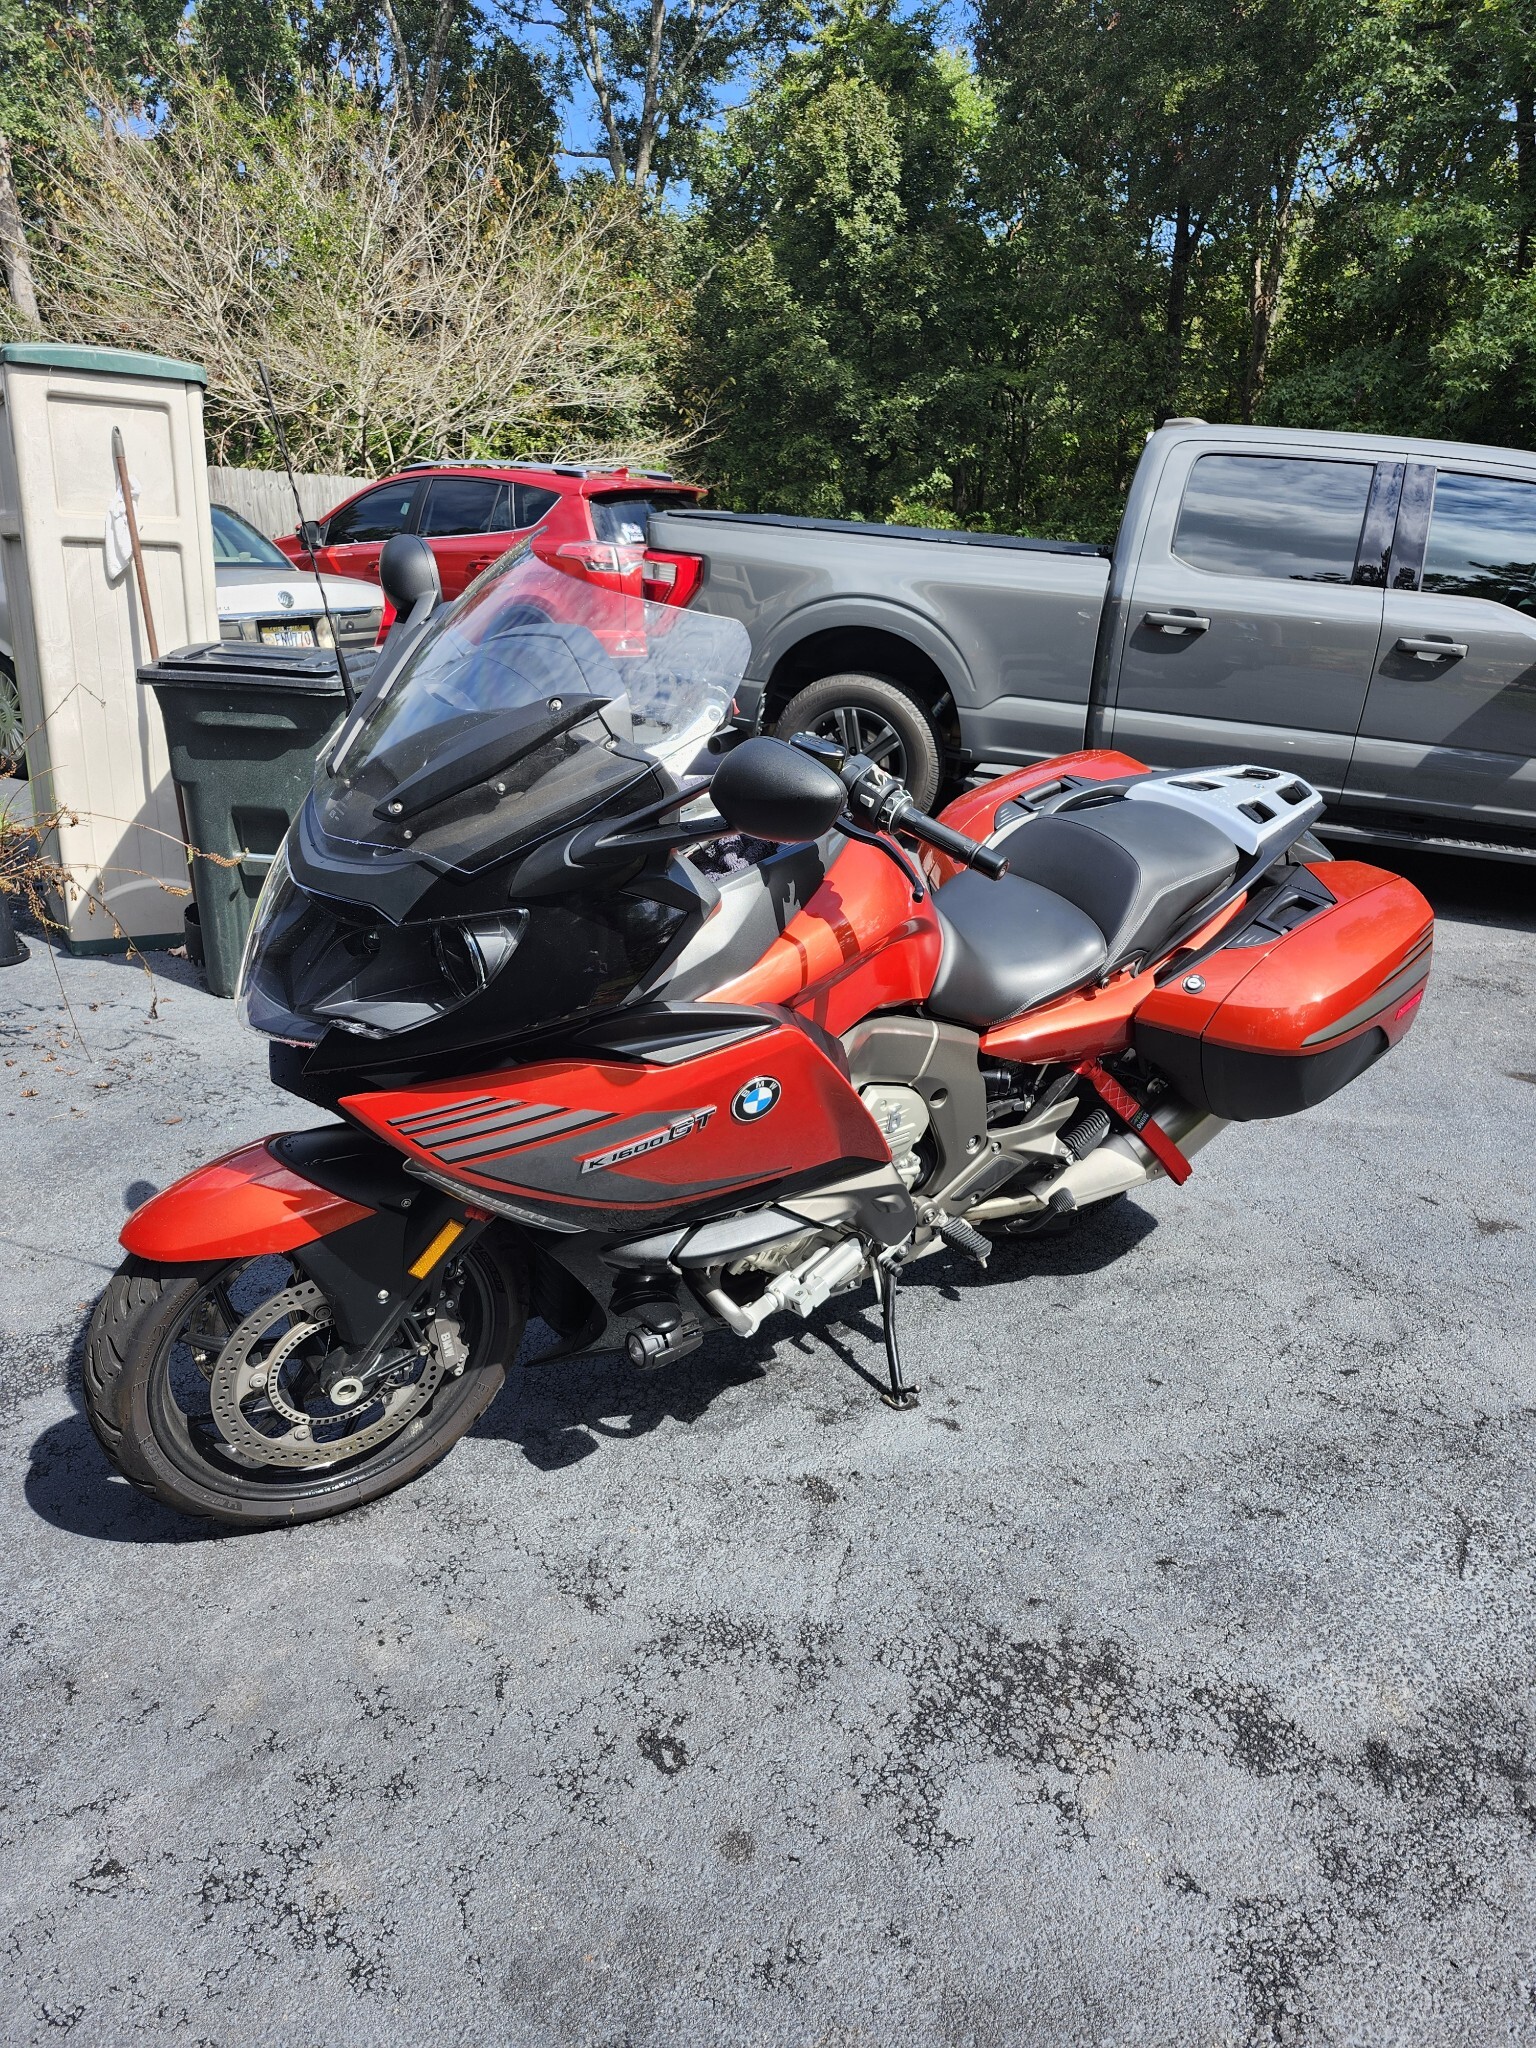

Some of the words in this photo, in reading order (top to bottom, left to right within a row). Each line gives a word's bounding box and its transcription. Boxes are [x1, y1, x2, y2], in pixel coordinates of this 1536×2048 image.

[740, 1080, 779, 1098] BMW
[589, 1157, 606, 1169] K
[611, 1136, 664, 1162] 1600
[669, 1105, 717, 1141] GT
[440, 1332, 455, 1358] BMW
